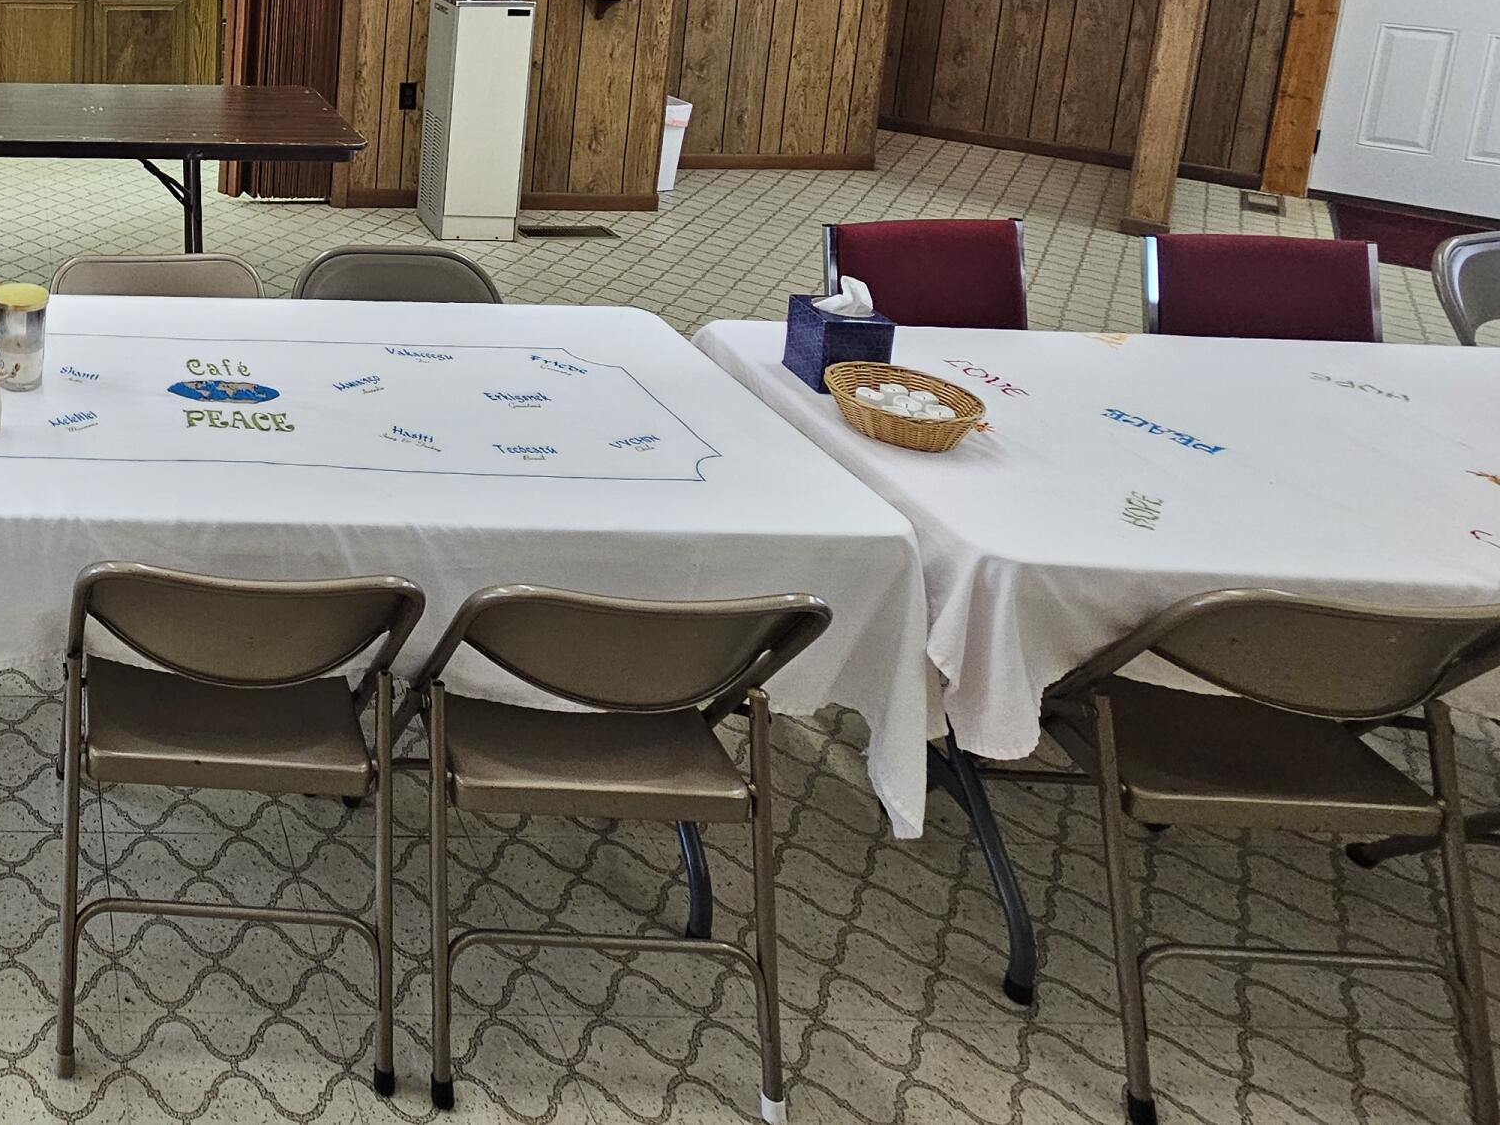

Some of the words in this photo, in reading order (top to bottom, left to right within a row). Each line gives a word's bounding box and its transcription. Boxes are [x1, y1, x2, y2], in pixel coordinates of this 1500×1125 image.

[185, 358, 252, 377] Café
[182, 408, 296, 433] PEACE
[1100, 408, 1228, 456] PEACE
